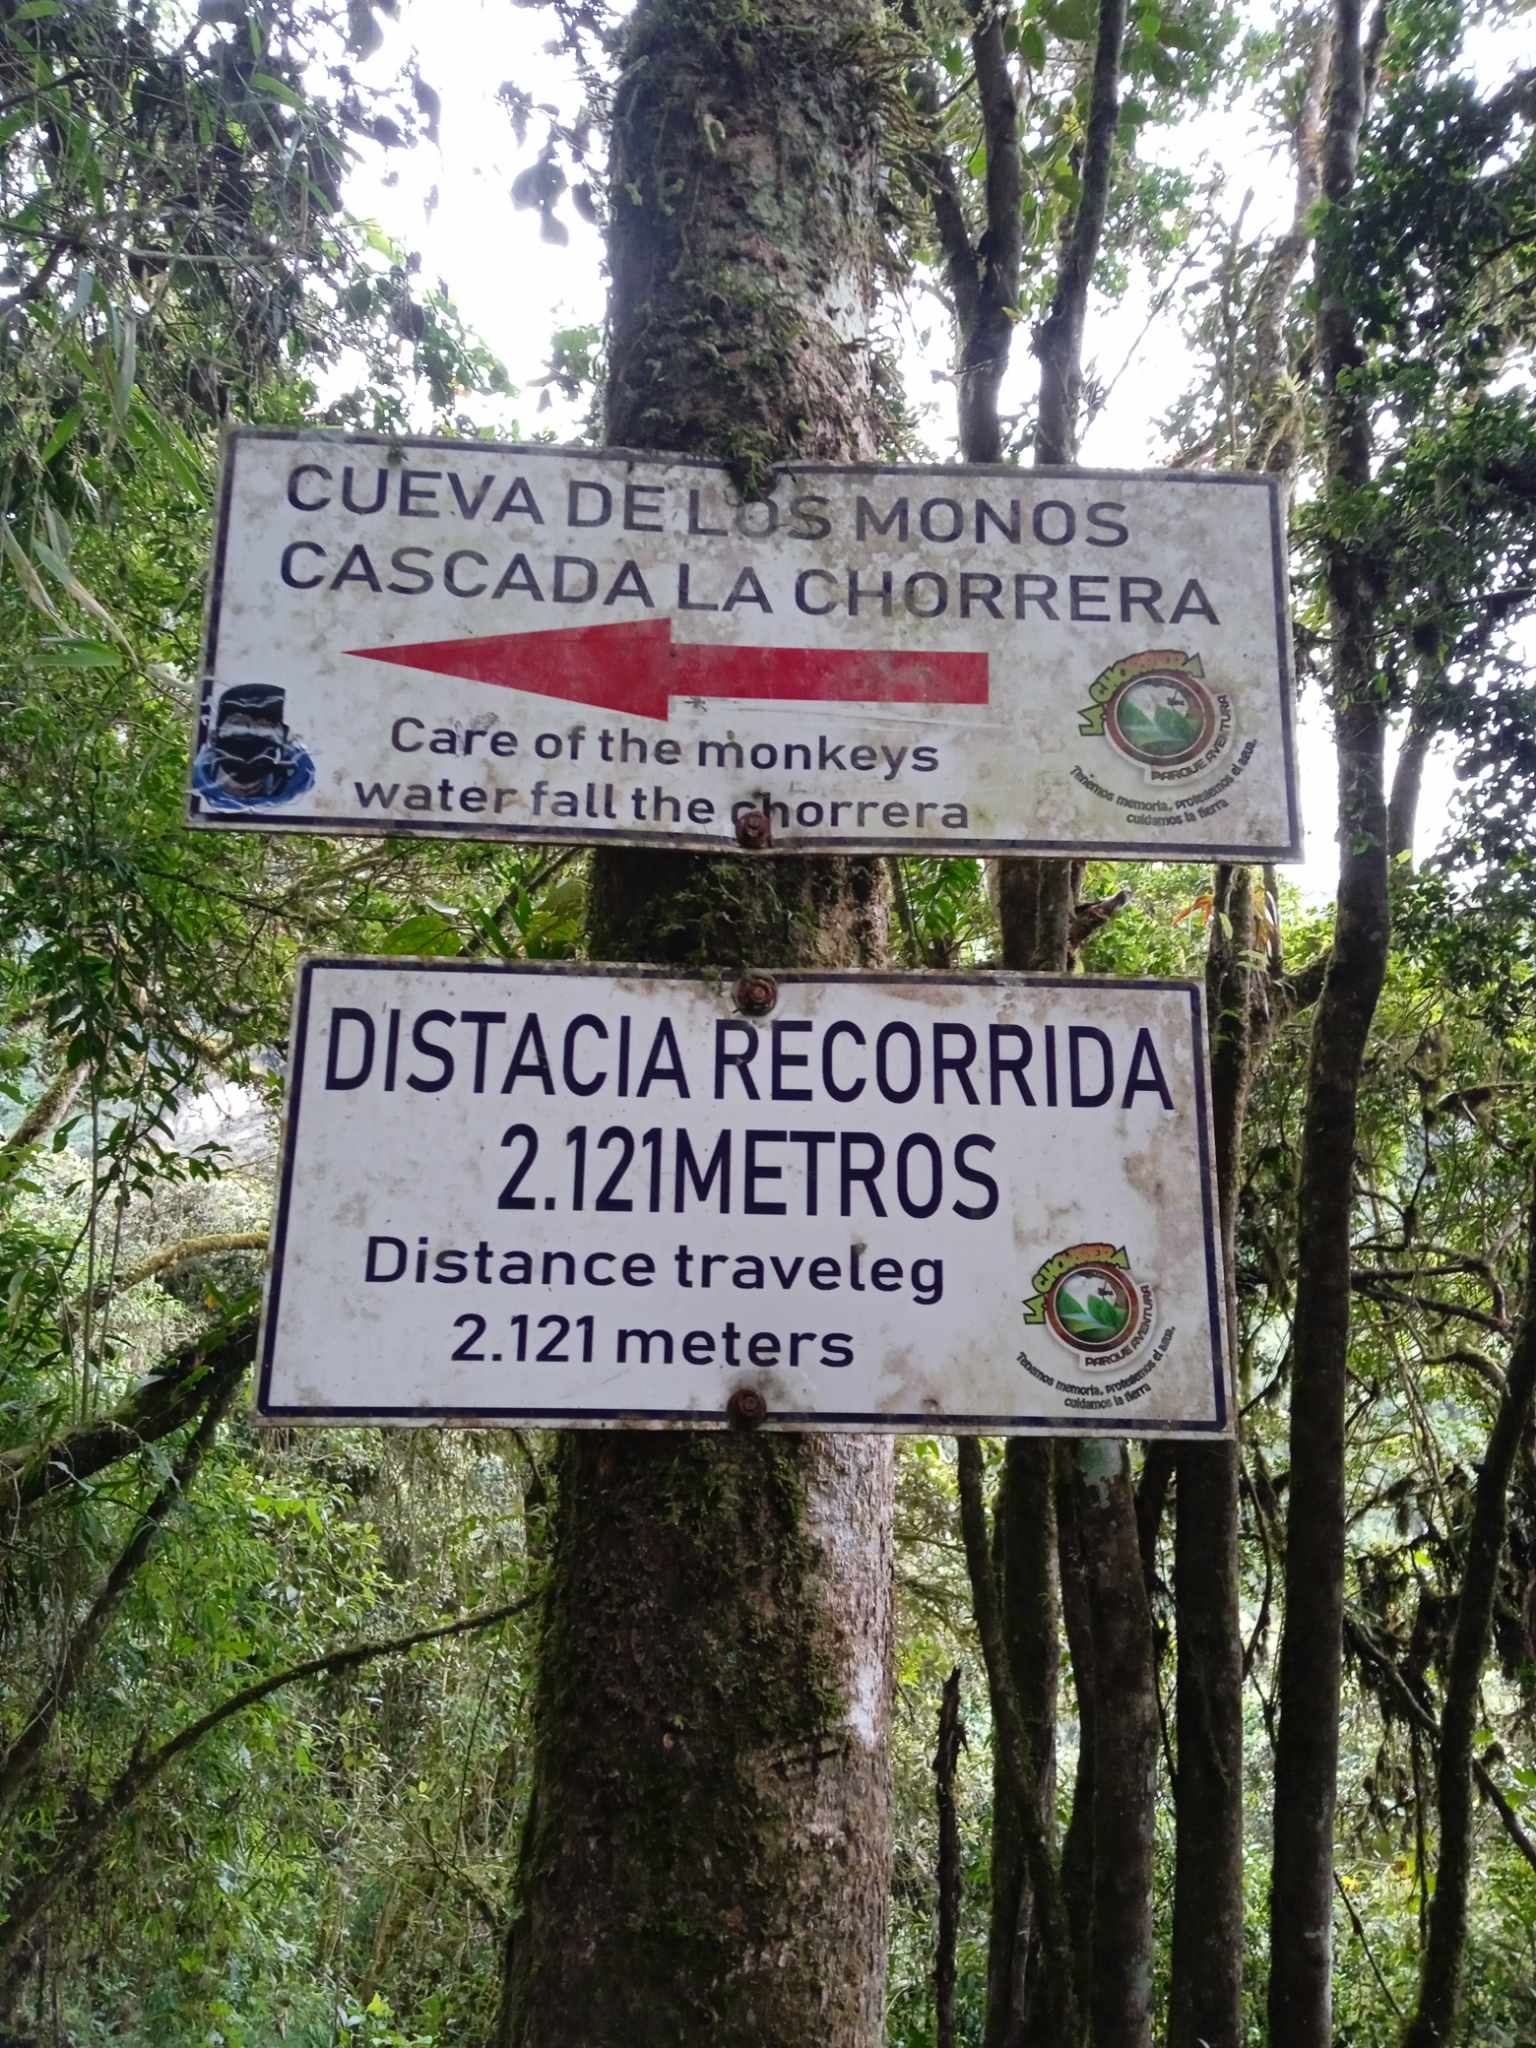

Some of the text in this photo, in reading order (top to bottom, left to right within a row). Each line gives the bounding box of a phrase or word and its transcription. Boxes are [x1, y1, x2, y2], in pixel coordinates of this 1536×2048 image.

[287, 464, 1129, 548] CUEVA DE LOS MONOS
[281, 541, 1220, 626] CASCADA LA CHORRERA
[391, 717, 939, 781] Care of the monkeys
[1151, 695, 1232, 780] PARQUE AVENTURA
[354, 780, 969, 829] water fall the chorrera
[1126, 799, 1230, 826] cuidamos la tierra
[324, 1007, 1175, 1111] DISTACIA RECORRIDA
[364, 1236, 944, 1306] Distance traveleg
[451, 1313, 854, 1369] 2.121 meters
[1085, 1284, 1154, 1367] PARQUE AVENTURA
